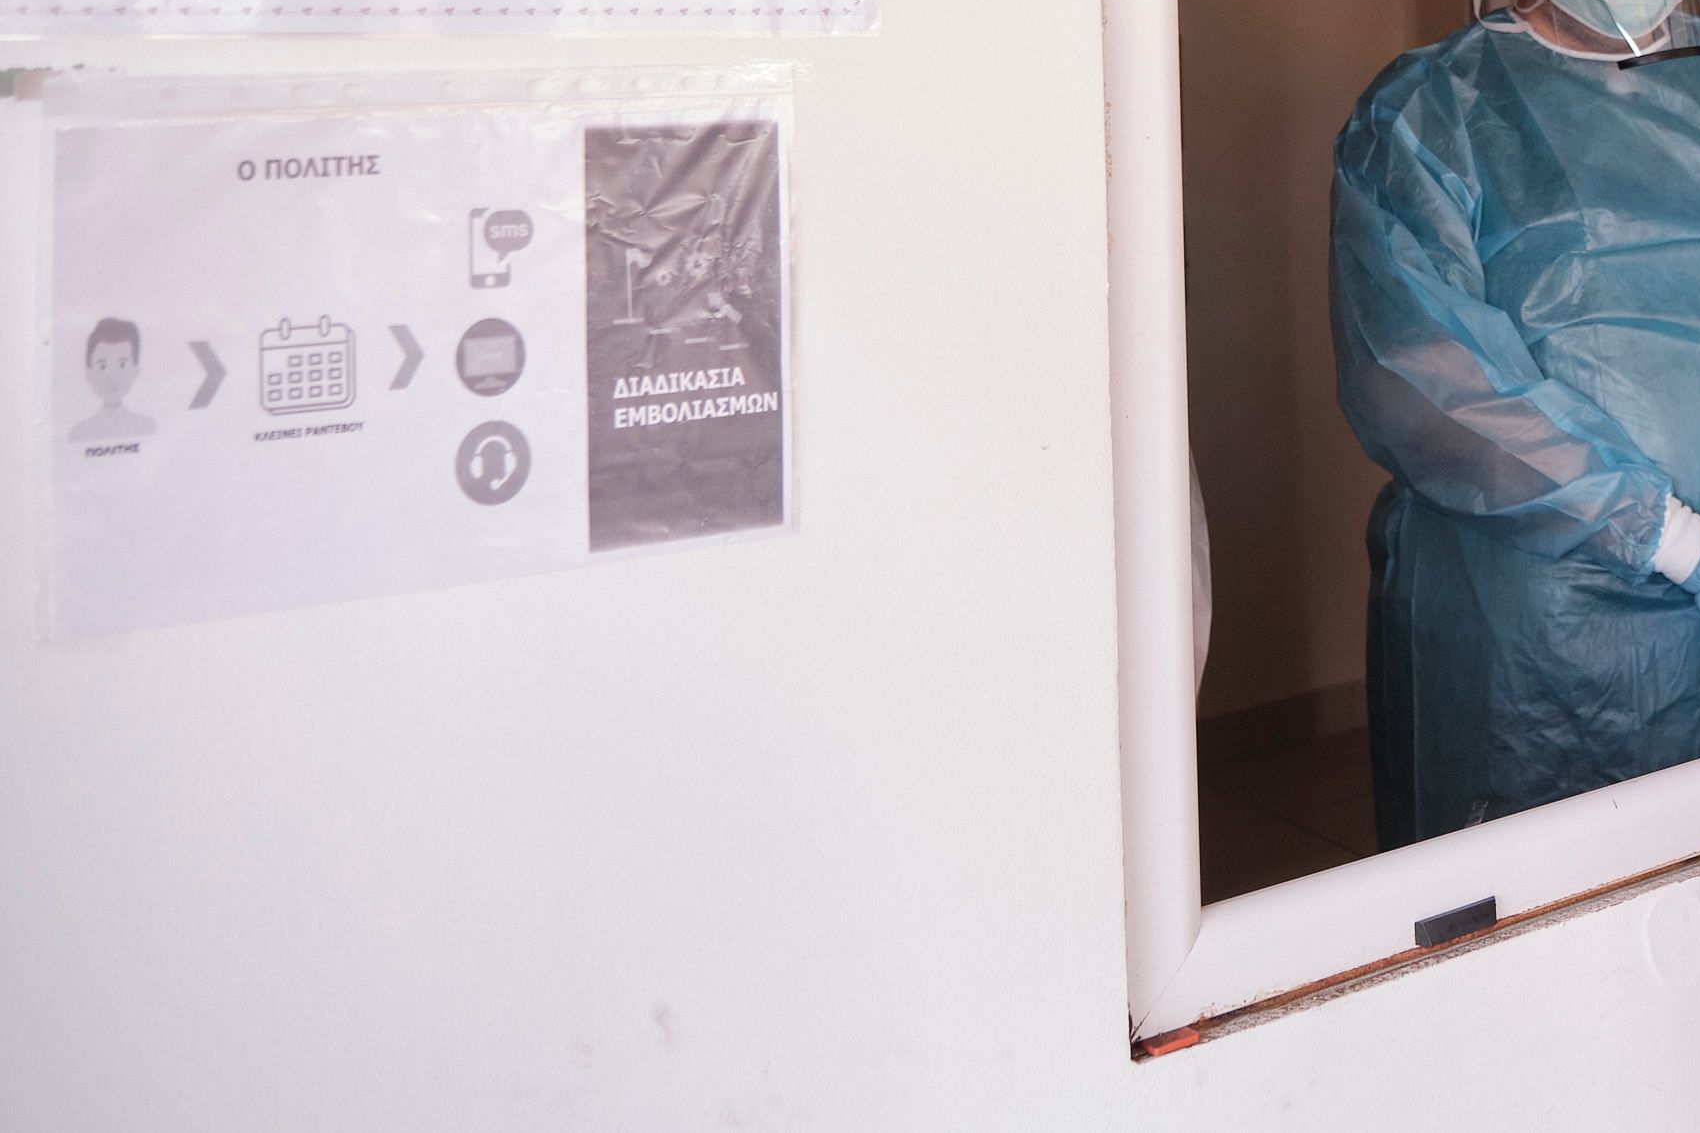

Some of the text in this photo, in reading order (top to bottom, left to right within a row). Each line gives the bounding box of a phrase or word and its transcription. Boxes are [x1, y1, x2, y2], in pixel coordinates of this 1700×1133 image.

[237, 154, 381, 182] Ο ΠΟΛΙΤΗΣ
[489, 223, 530, 239] sms
[613, 366, 746, 400] ΔΙΑΔΙΚΑΣΙΑ
[613, 391, 779, 429] ΕΜΒΟΛΙΑΣΜΩΝ
